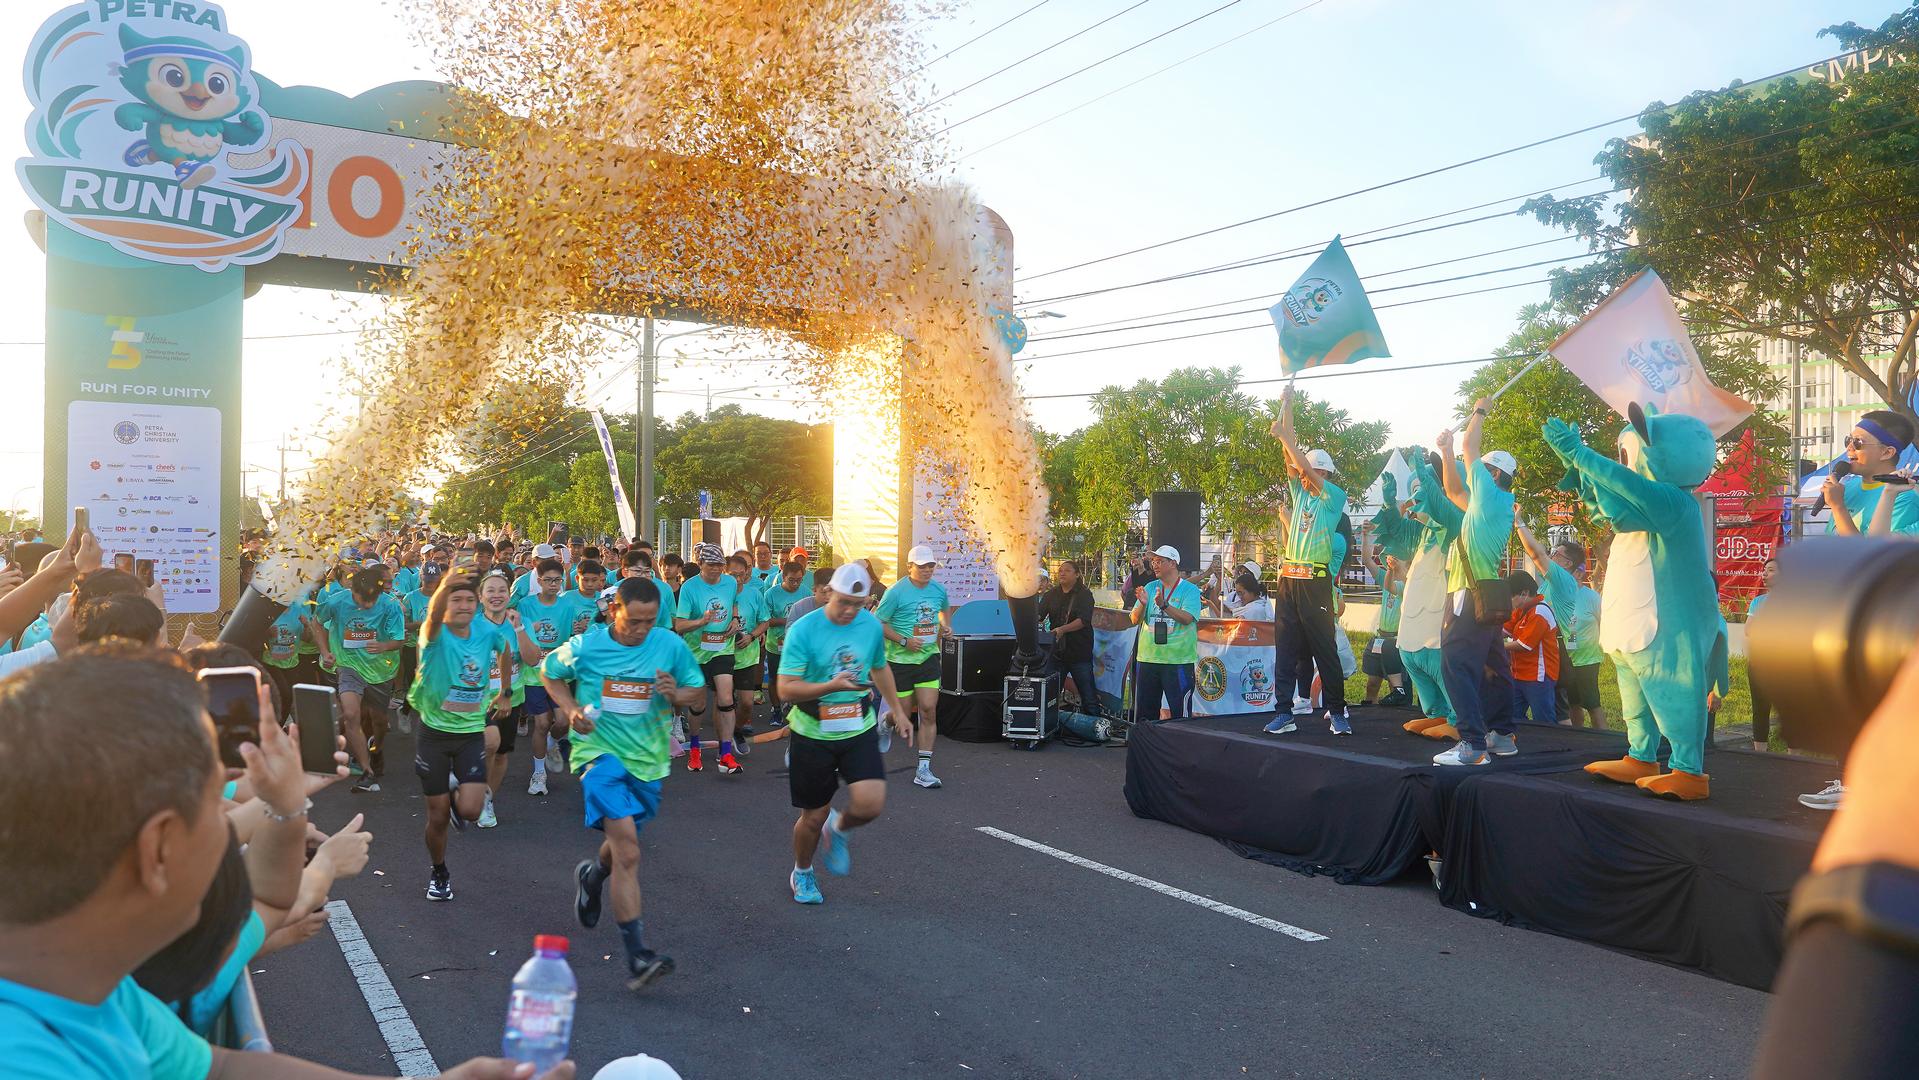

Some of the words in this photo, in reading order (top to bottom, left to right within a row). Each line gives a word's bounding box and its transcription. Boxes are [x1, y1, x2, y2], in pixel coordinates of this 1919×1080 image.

[100, 0, 221, 33] PETRA
[59, 169, 266, 234] RUNITY
[1283, 294, 1306, 323] RUNITY
[80, 382, 118, 394] RUN
[122, 384, 157, 396] FOR
[162, 386, 212, 399] UNITY
[1716, 536, 1772, 564] dDay
[610, 683, 646, 694] 50842
[1245, 692, 1270, 701] RUNITY
